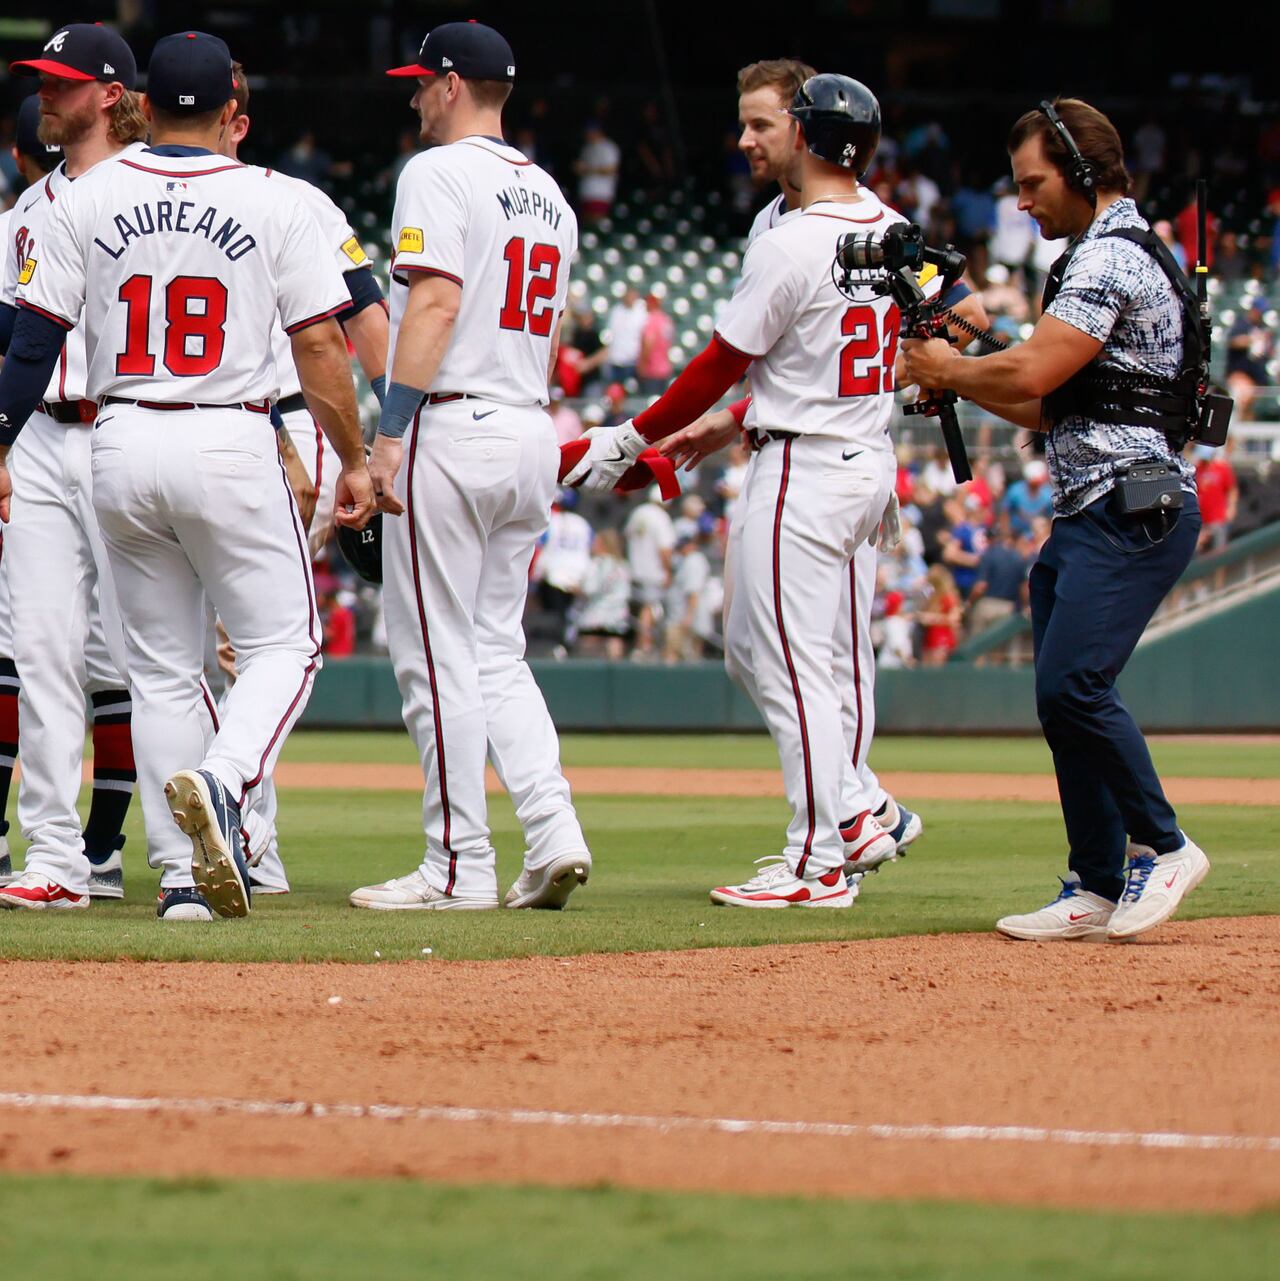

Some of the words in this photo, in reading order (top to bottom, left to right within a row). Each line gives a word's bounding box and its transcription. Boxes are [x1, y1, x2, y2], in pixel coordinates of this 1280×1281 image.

[843, 143, 857, 158] 24
[94, 200, 257, 262] LAUREANO
[496, 186, 562, 231] MURPHY
[499, 236, 561, 337] 12
[115, 274, 228, 377] 18
[362, 529, 375, 544] 27
